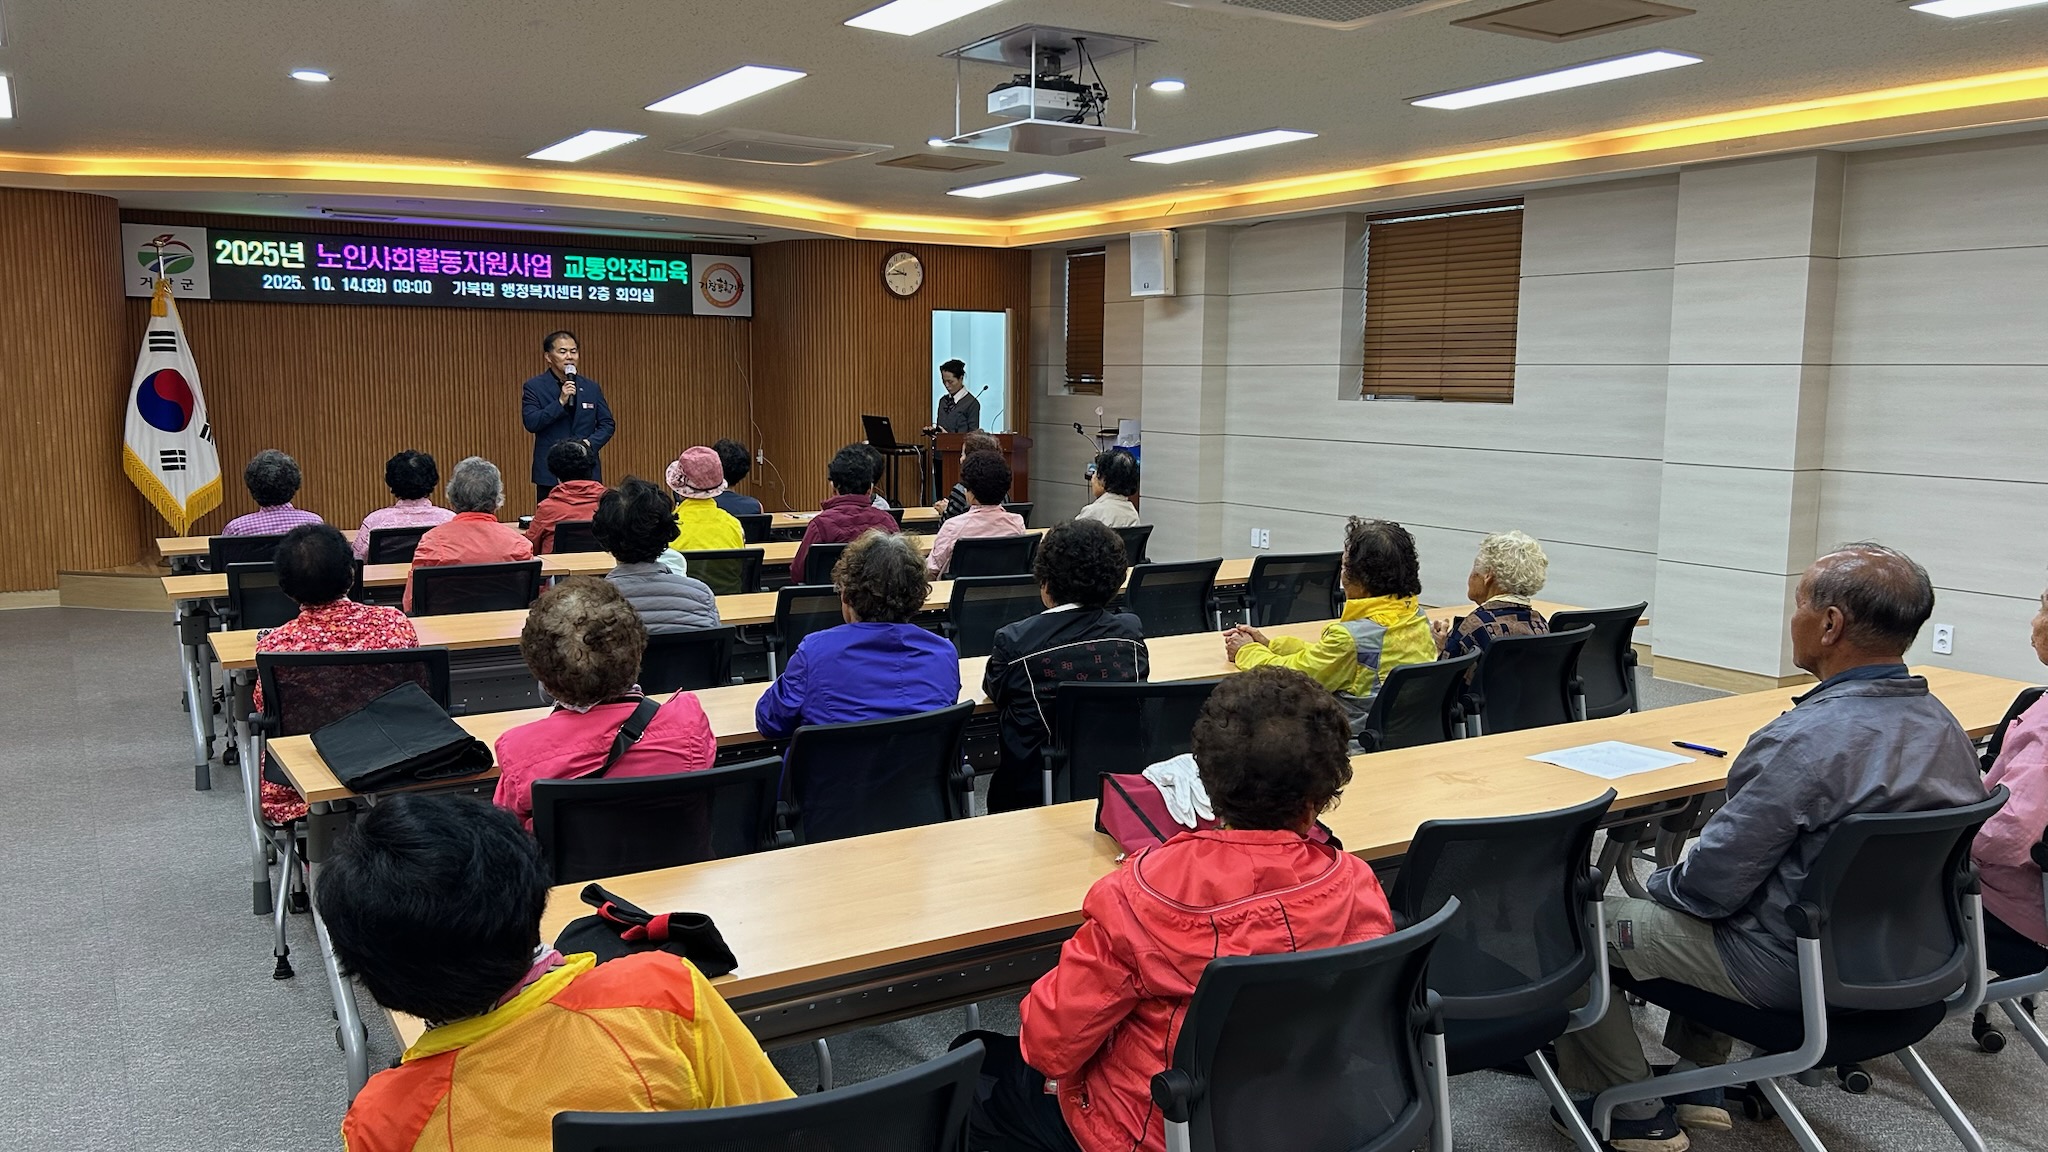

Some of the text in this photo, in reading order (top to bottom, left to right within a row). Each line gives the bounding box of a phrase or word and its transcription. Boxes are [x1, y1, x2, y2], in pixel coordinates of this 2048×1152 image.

[214, 239, 689, 285] 2025년 노인사회활동지원사업 교통안전교육
[139, 276, 195, 291] 거군
[262, 274, 655, 303] 2025. 10. 14.(화) 09:00 가북면 행정복지센터 2층 회의실
